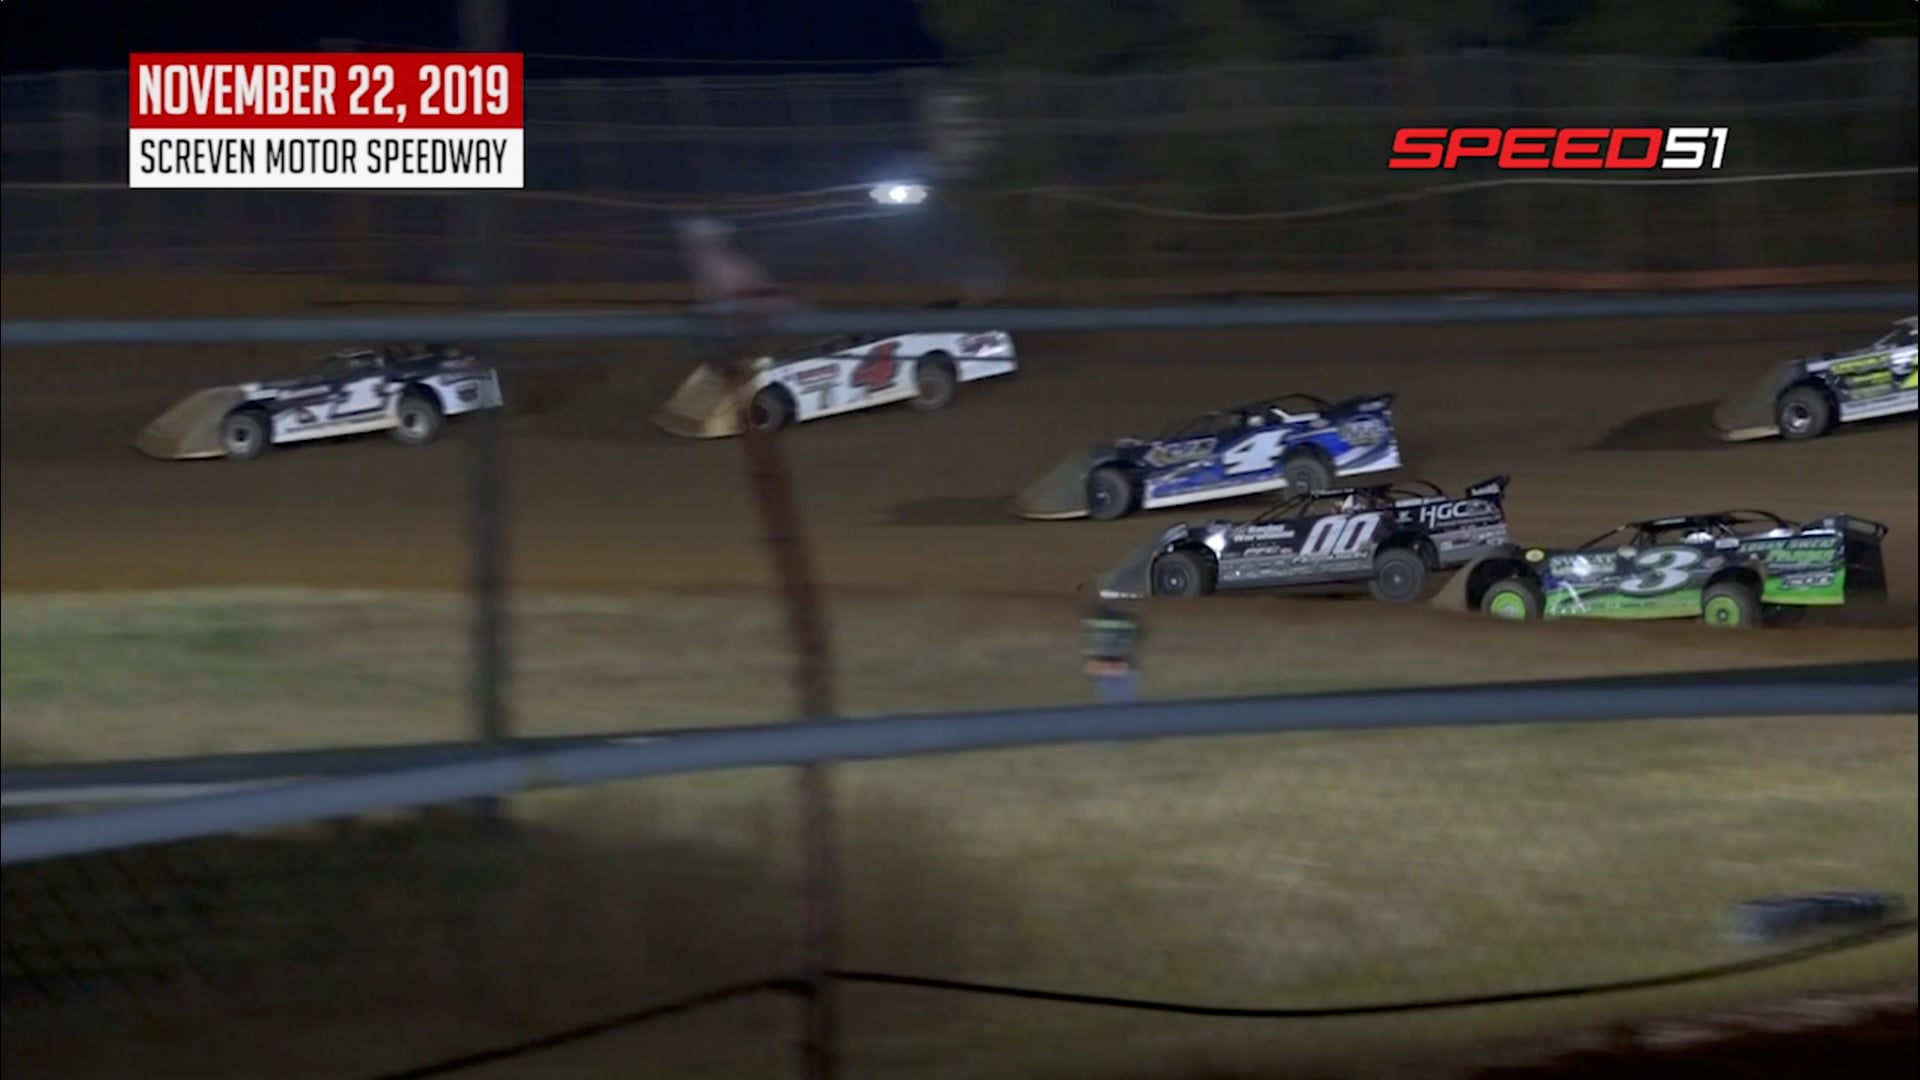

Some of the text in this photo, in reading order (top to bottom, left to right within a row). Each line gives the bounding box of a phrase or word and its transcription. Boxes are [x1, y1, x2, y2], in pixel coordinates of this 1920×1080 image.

[852, 341, 900, 392] 4
[1222, 427, 1294, 475] 4
[1299, 512, 1380, 556] 00
[1419, 501, 1468, 530] HGC
[1619, 547, 1701, 594] 3
